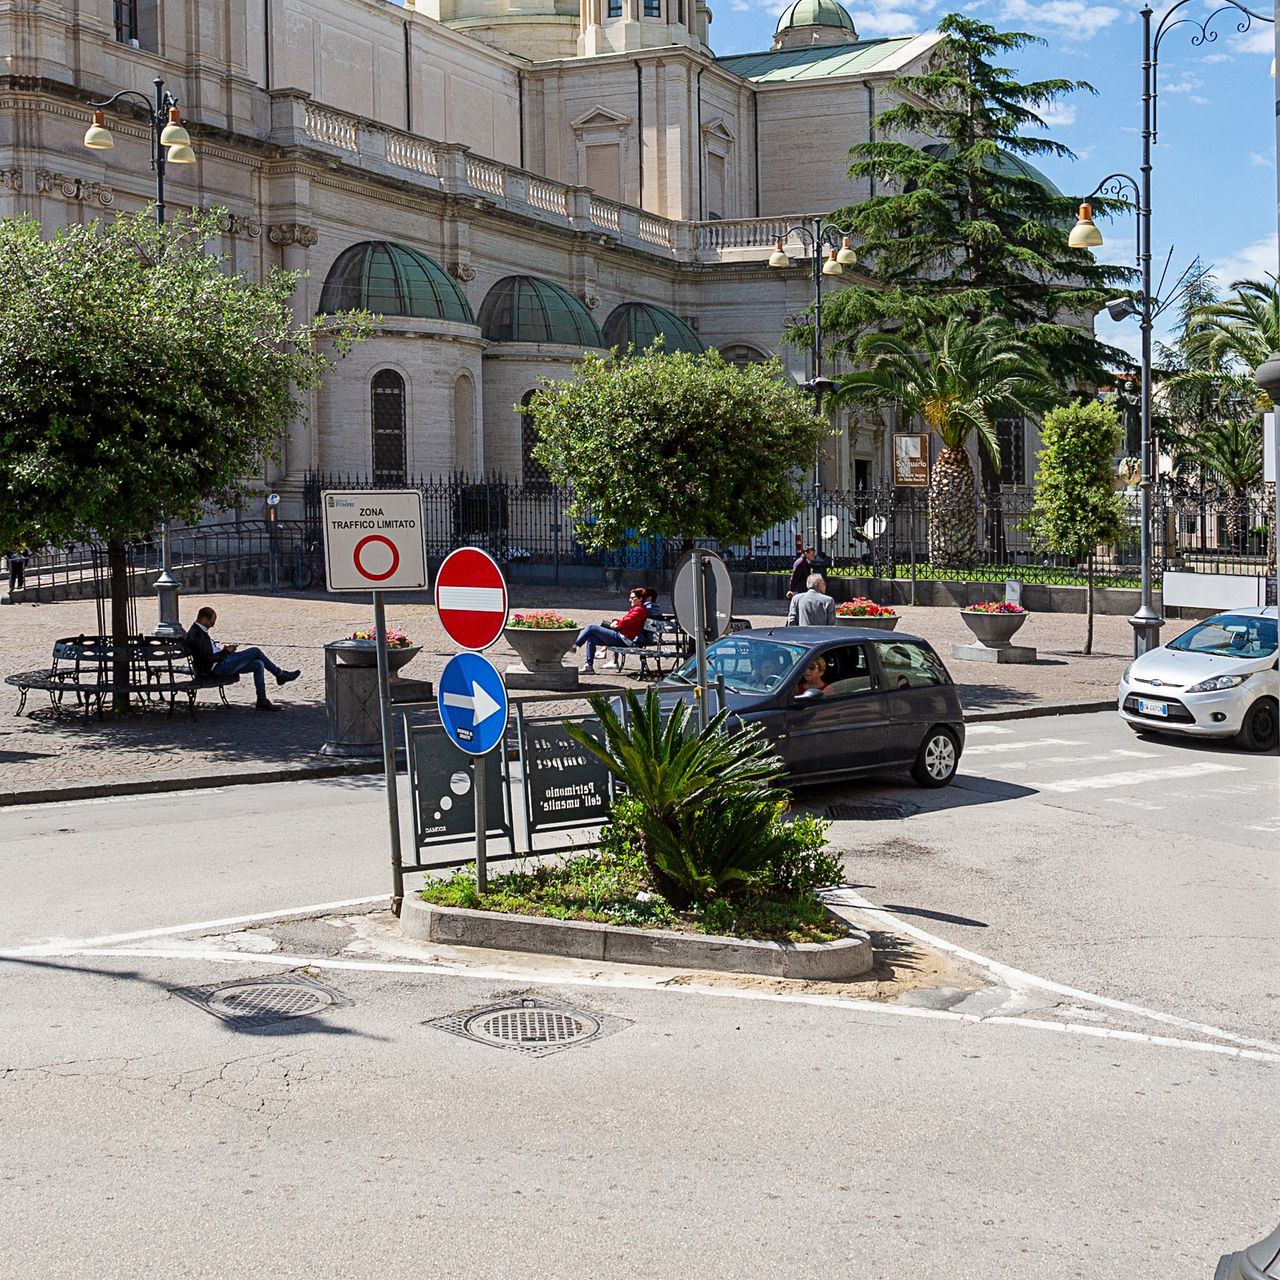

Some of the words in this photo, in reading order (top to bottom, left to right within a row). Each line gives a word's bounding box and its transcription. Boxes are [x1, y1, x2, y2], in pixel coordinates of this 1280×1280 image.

[359, 508, 385, 517] ZONA
[332, 520, 375, 529] TRAFFICO
[376, 520, 416, 529] LIMITATO
